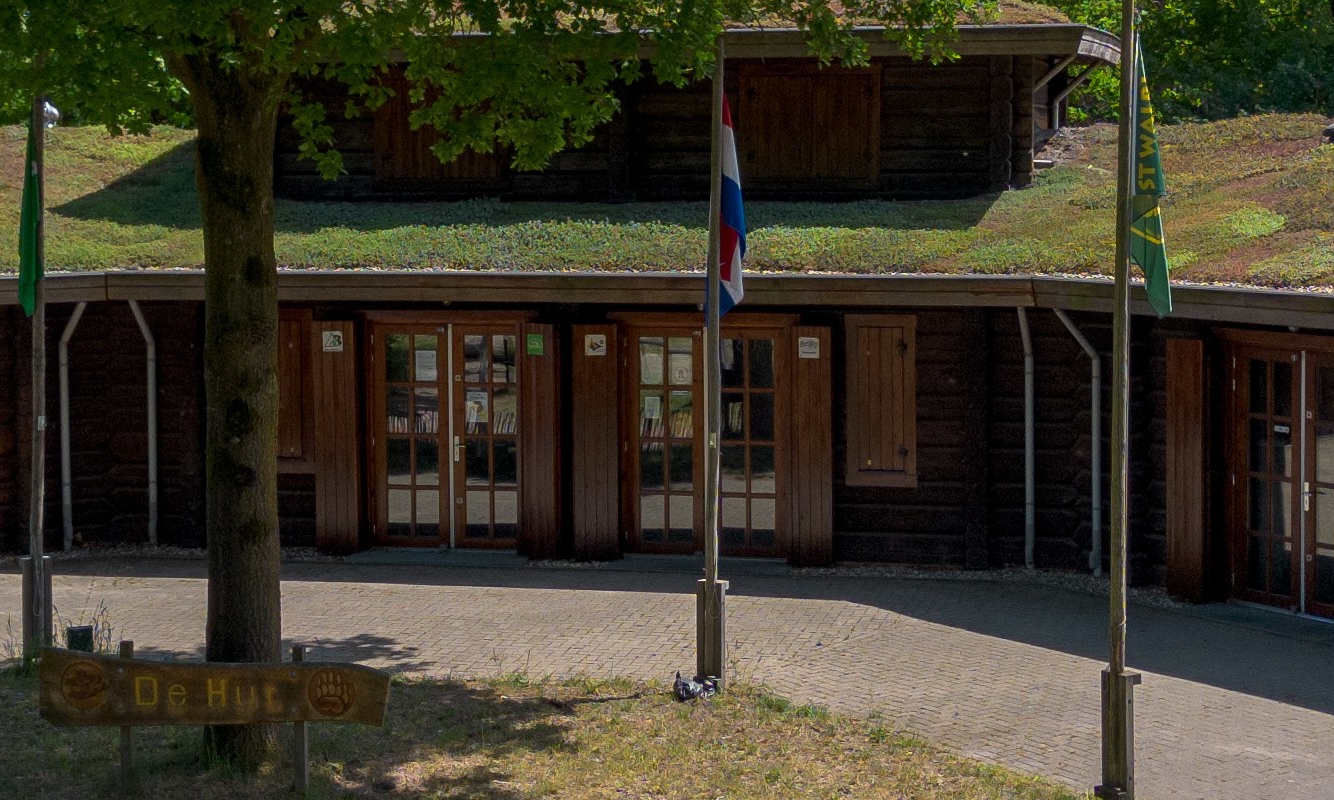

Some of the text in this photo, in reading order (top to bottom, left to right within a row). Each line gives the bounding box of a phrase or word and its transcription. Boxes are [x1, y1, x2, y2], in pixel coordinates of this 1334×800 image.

[1138, 163, 1156, 190] ST
[134, 676, 278, 707] De Hut
